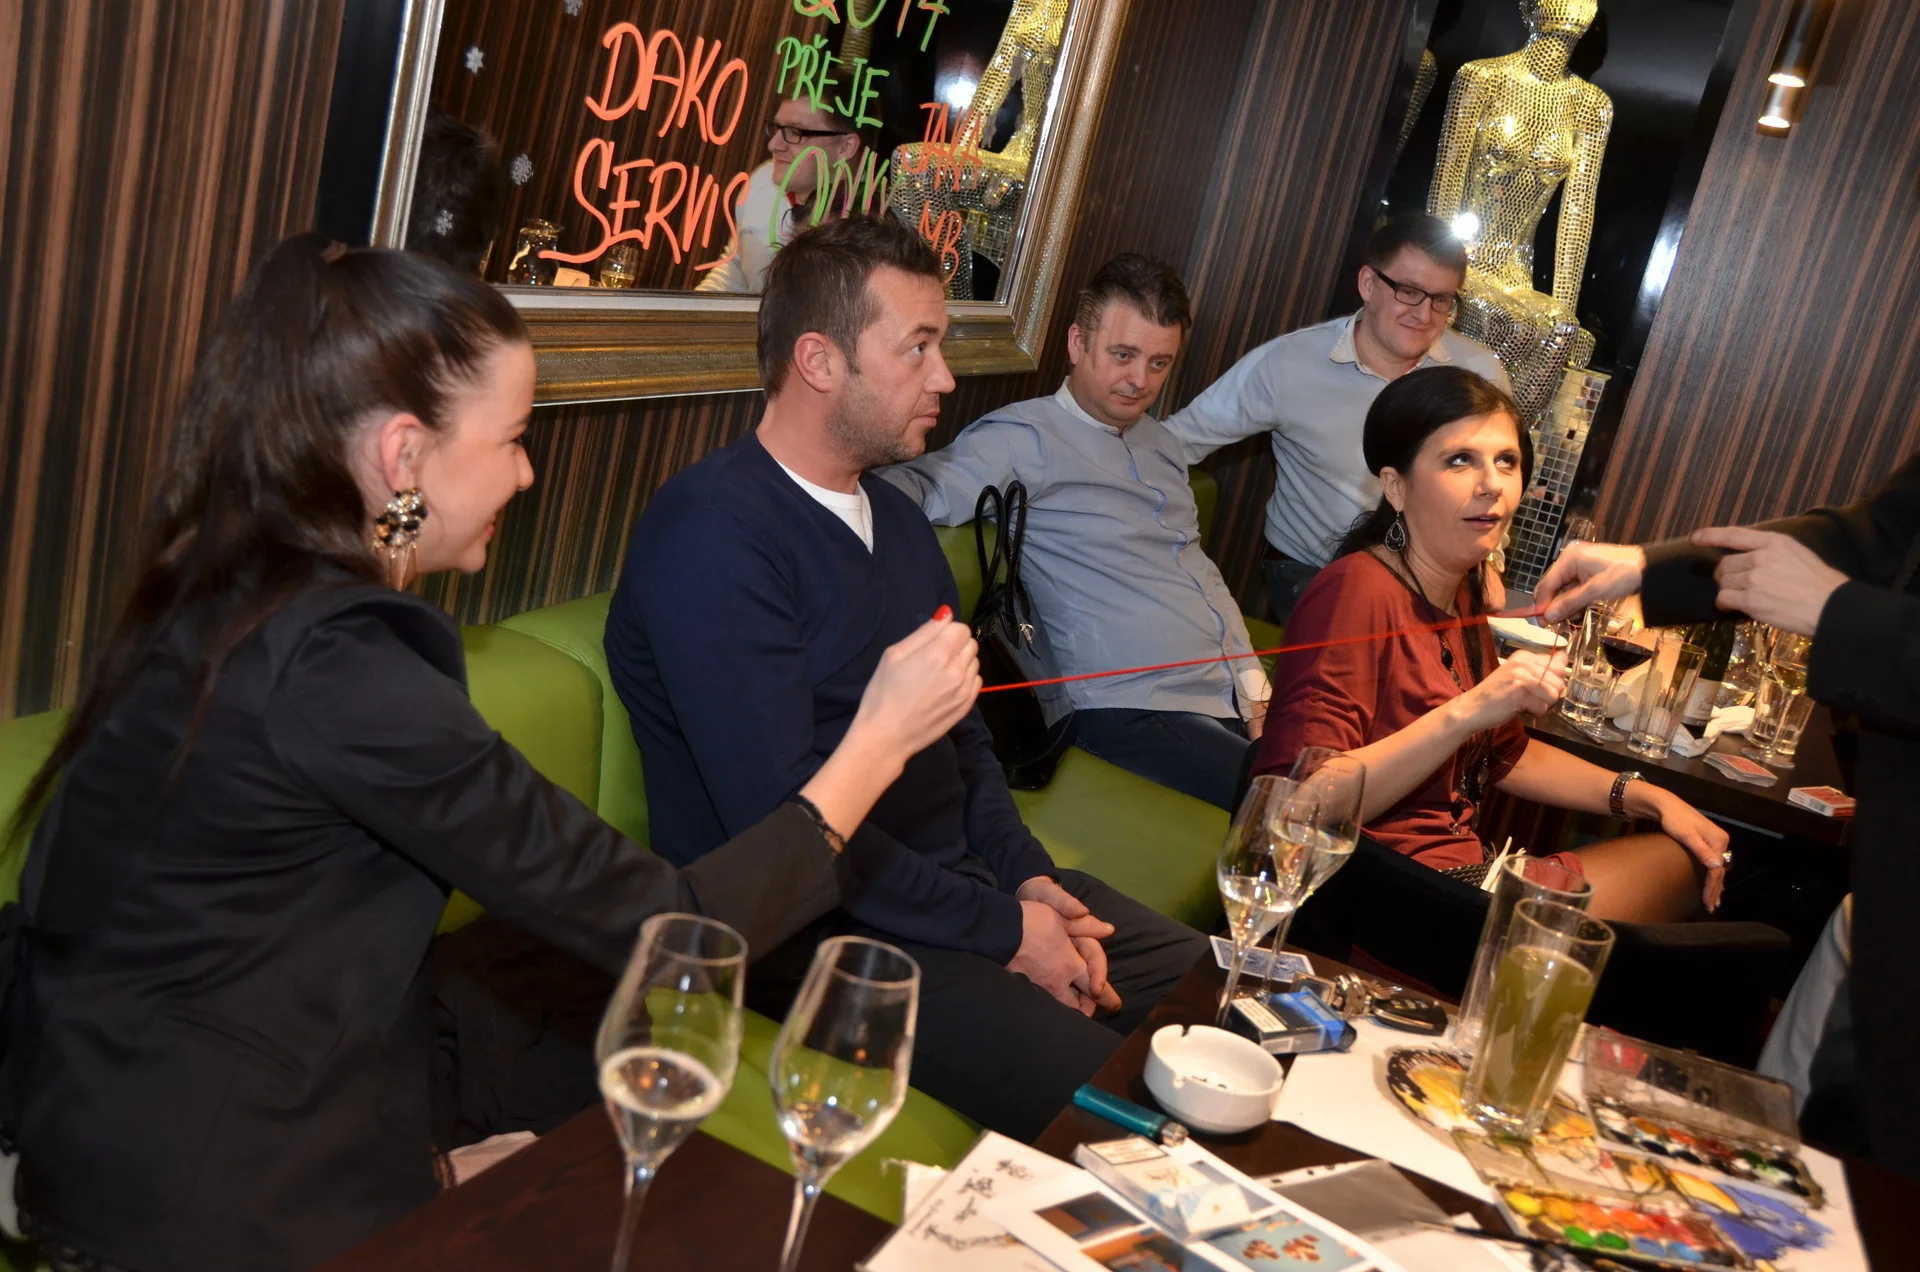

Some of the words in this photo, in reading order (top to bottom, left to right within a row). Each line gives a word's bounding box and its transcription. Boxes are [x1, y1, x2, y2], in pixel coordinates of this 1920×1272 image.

[586, 22, 748, 145] DAKO
[776, 34, 890, 128] PŘEJE
[537, 138, 750, 271] SERVIS
